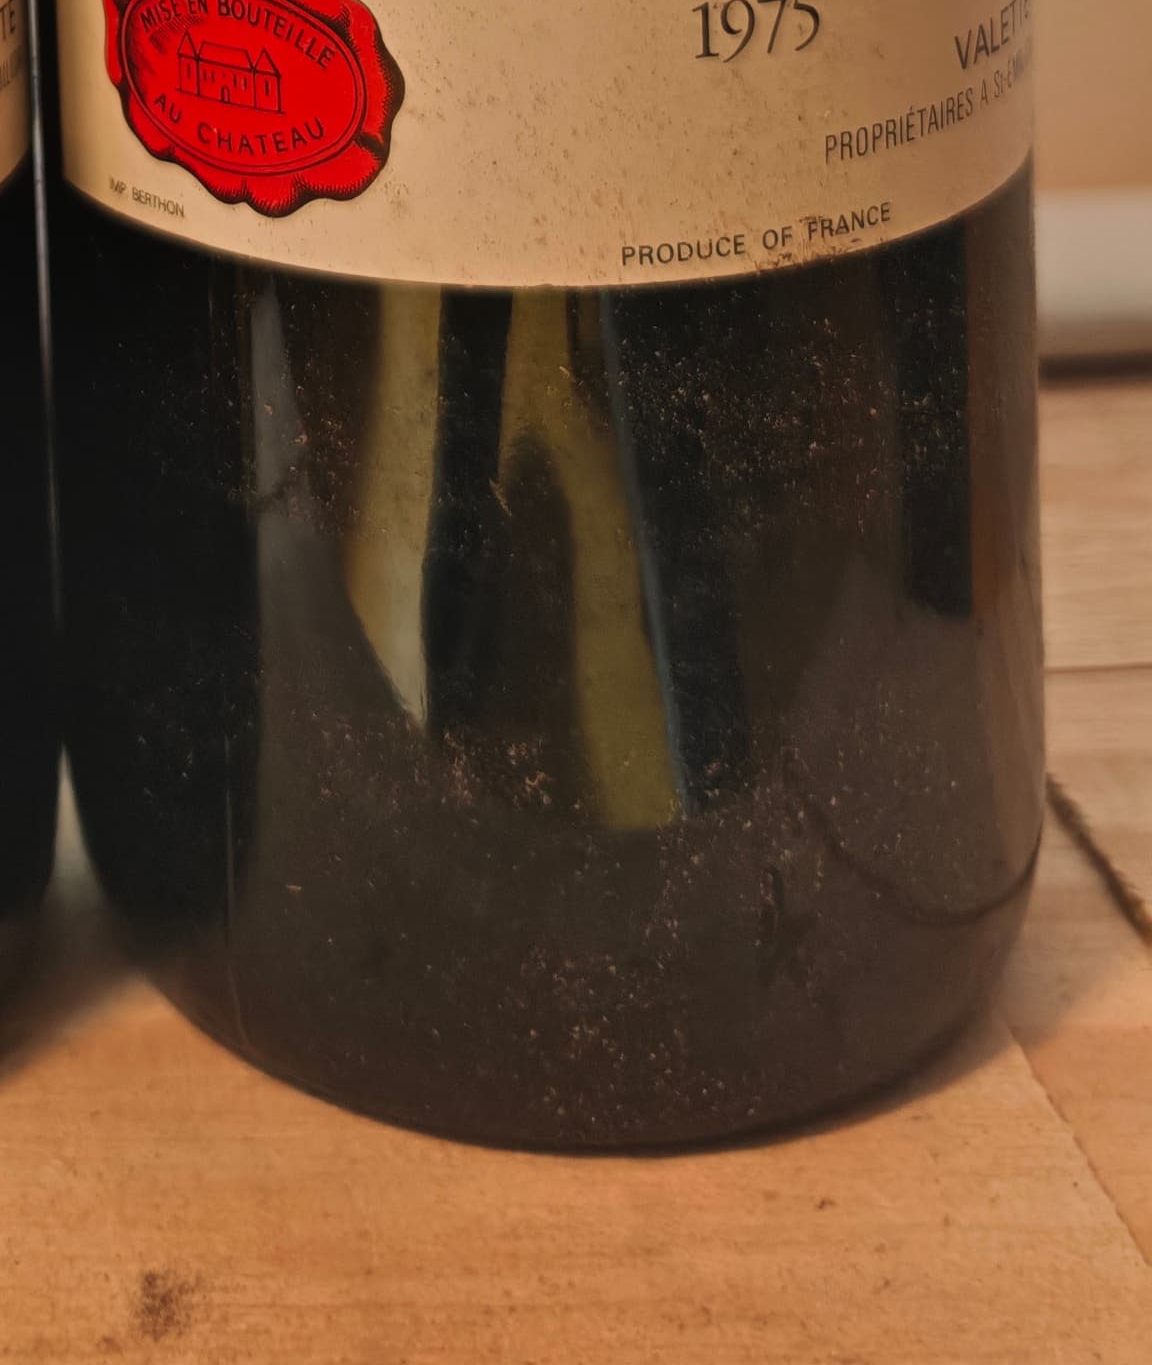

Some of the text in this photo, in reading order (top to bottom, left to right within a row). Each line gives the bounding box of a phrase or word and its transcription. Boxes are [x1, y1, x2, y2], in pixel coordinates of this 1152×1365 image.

[154, 92, 325, 156] AU CHATEAU
[825, 79, 990, 166] PROPRIÉTAIRES A
[131, 187, 185, 218] BERTHON
[621, 201, 892, 266] PRODUCE OF FRANCE
